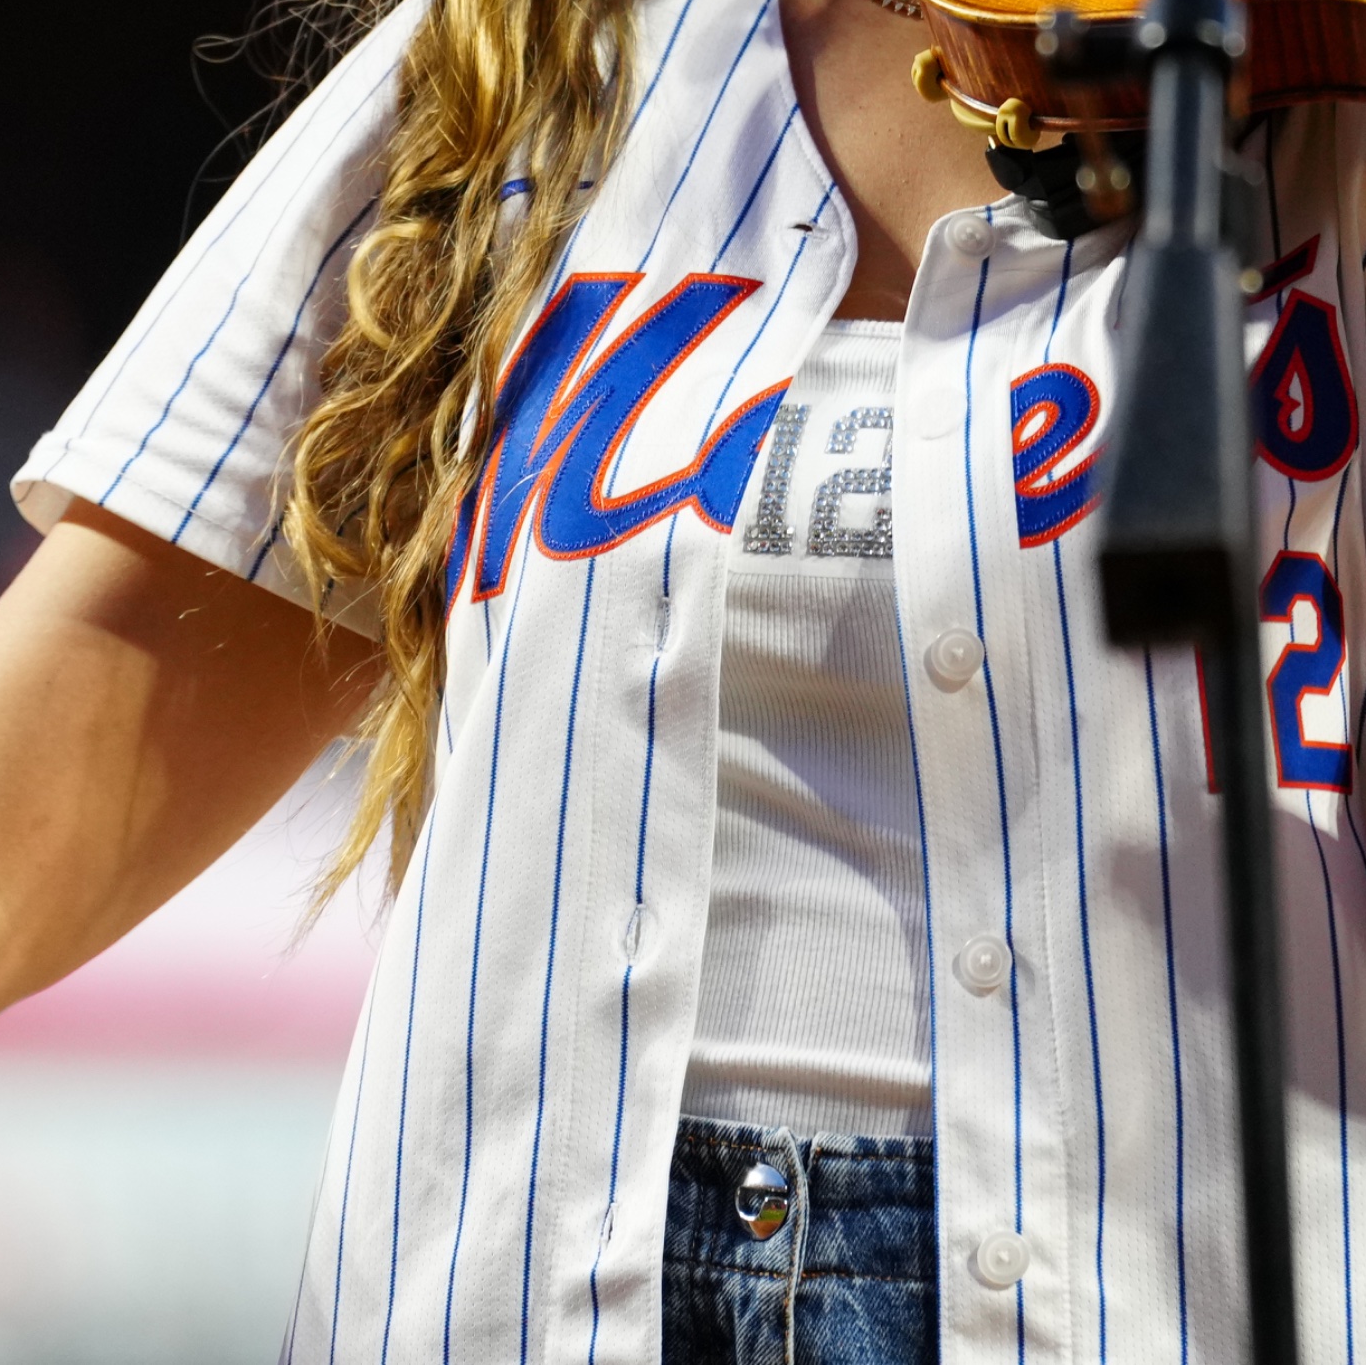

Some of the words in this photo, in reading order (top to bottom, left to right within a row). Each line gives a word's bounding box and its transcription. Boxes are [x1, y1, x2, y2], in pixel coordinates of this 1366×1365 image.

[444, 233, 1358, 623] Mes
[742, 403, 894, 558] 12
[1194, 549, 1353, 795] 2
